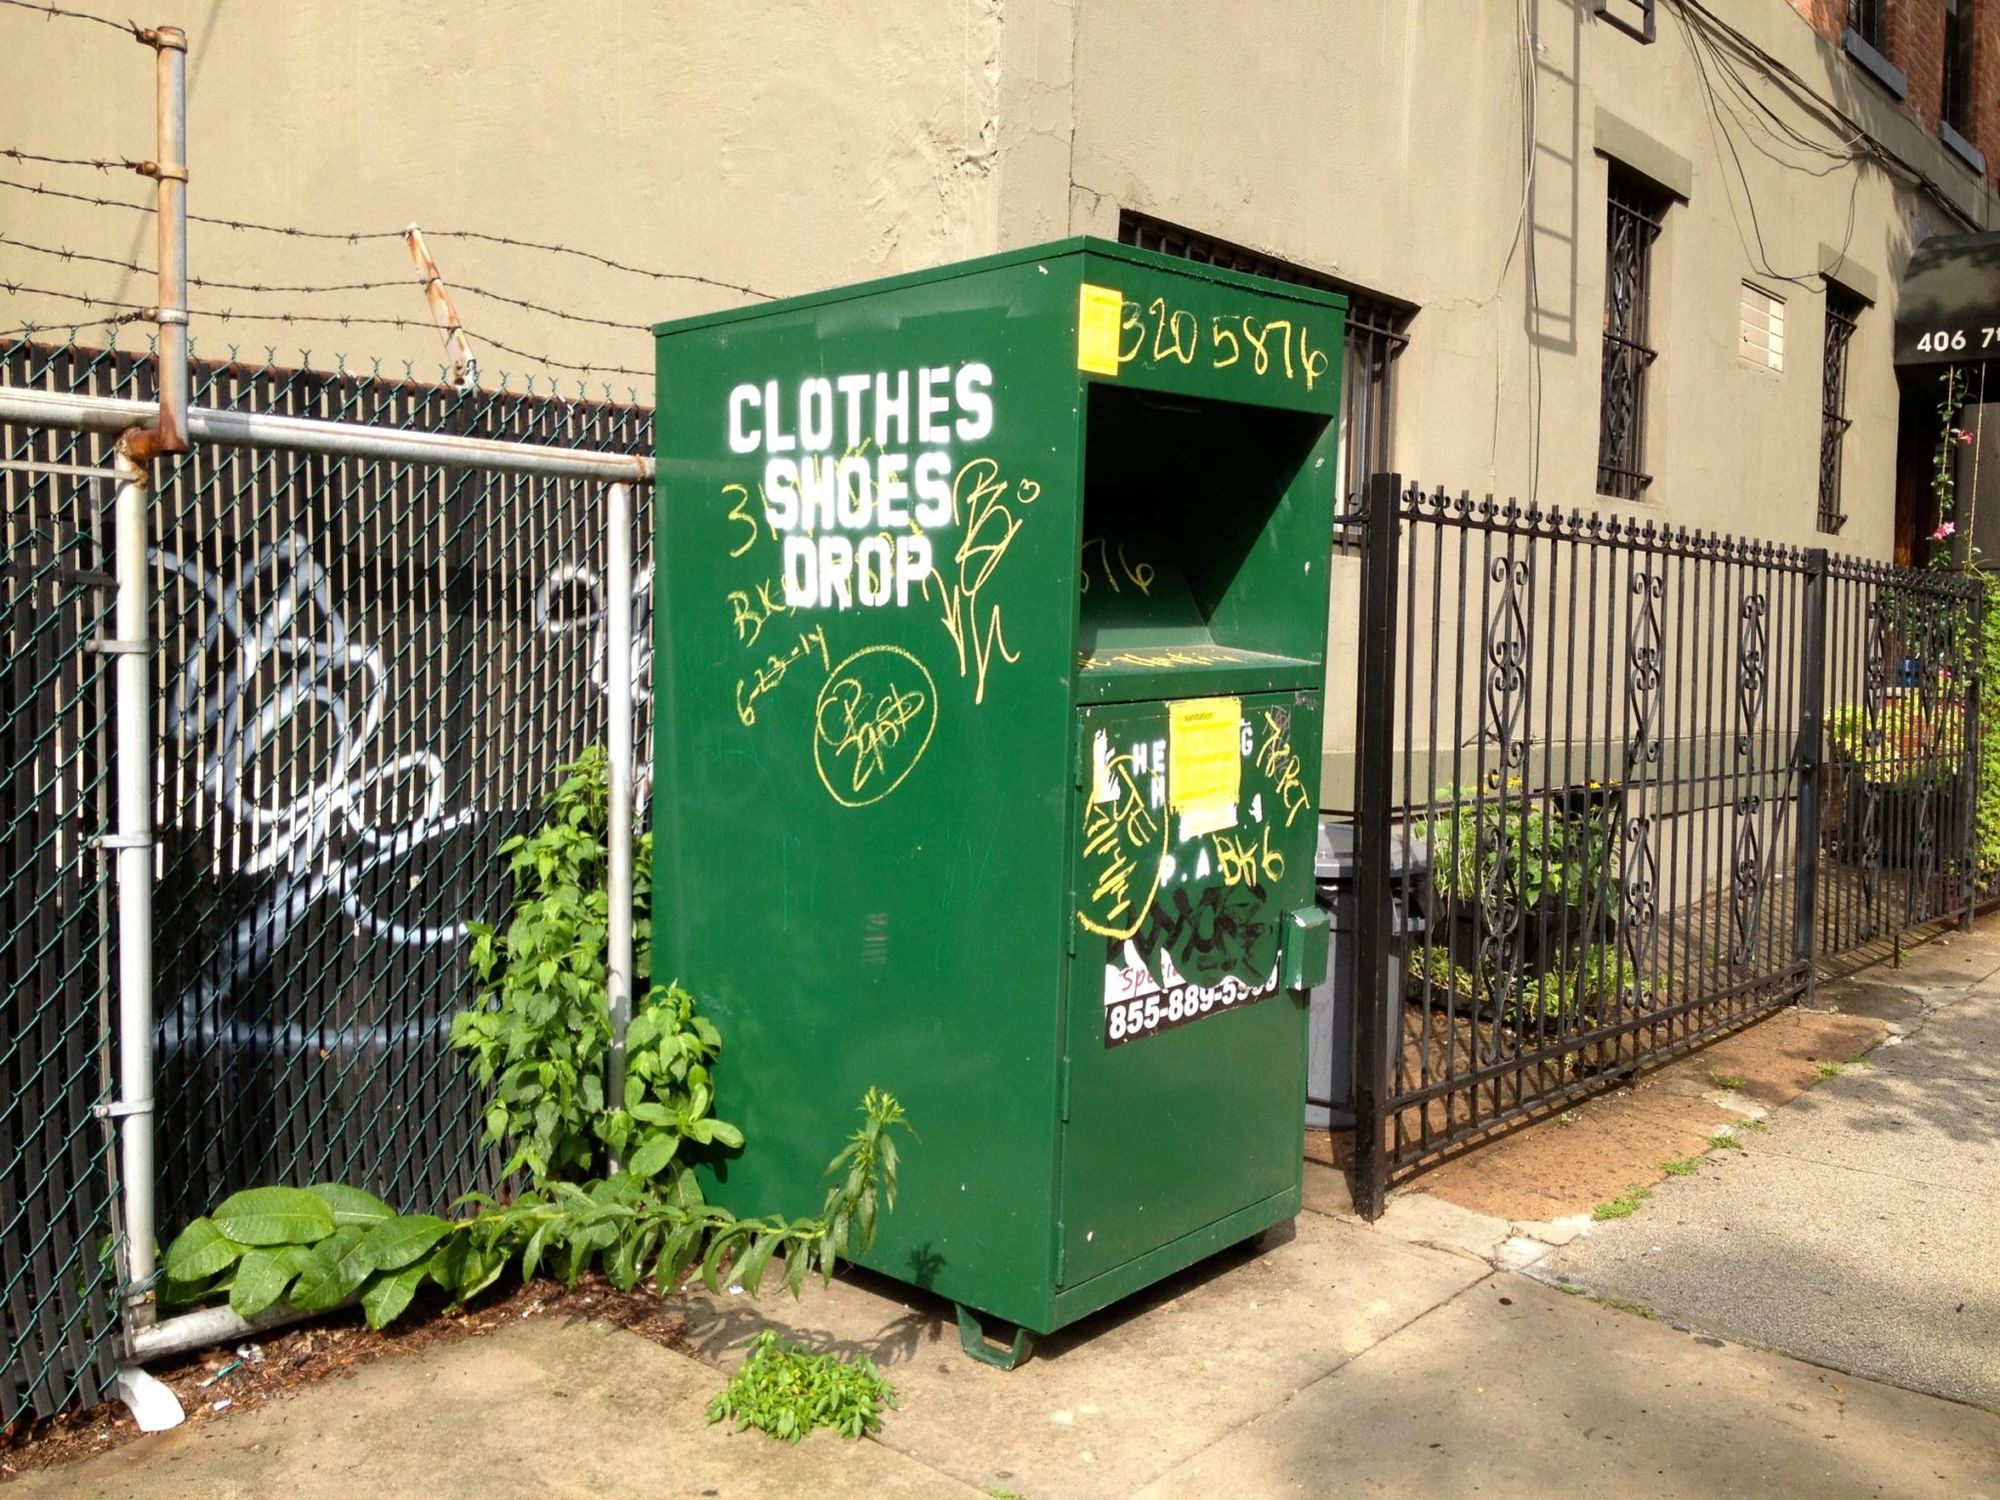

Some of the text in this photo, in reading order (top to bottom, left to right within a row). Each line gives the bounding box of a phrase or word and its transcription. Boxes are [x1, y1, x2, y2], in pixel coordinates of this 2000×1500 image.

[1916, 329, 1967, 352] 406
[729, 362, 993, 454] CLOTHES
[765, 451, 951, 530] SHOES
[783, 535, 933, 609] DROP
